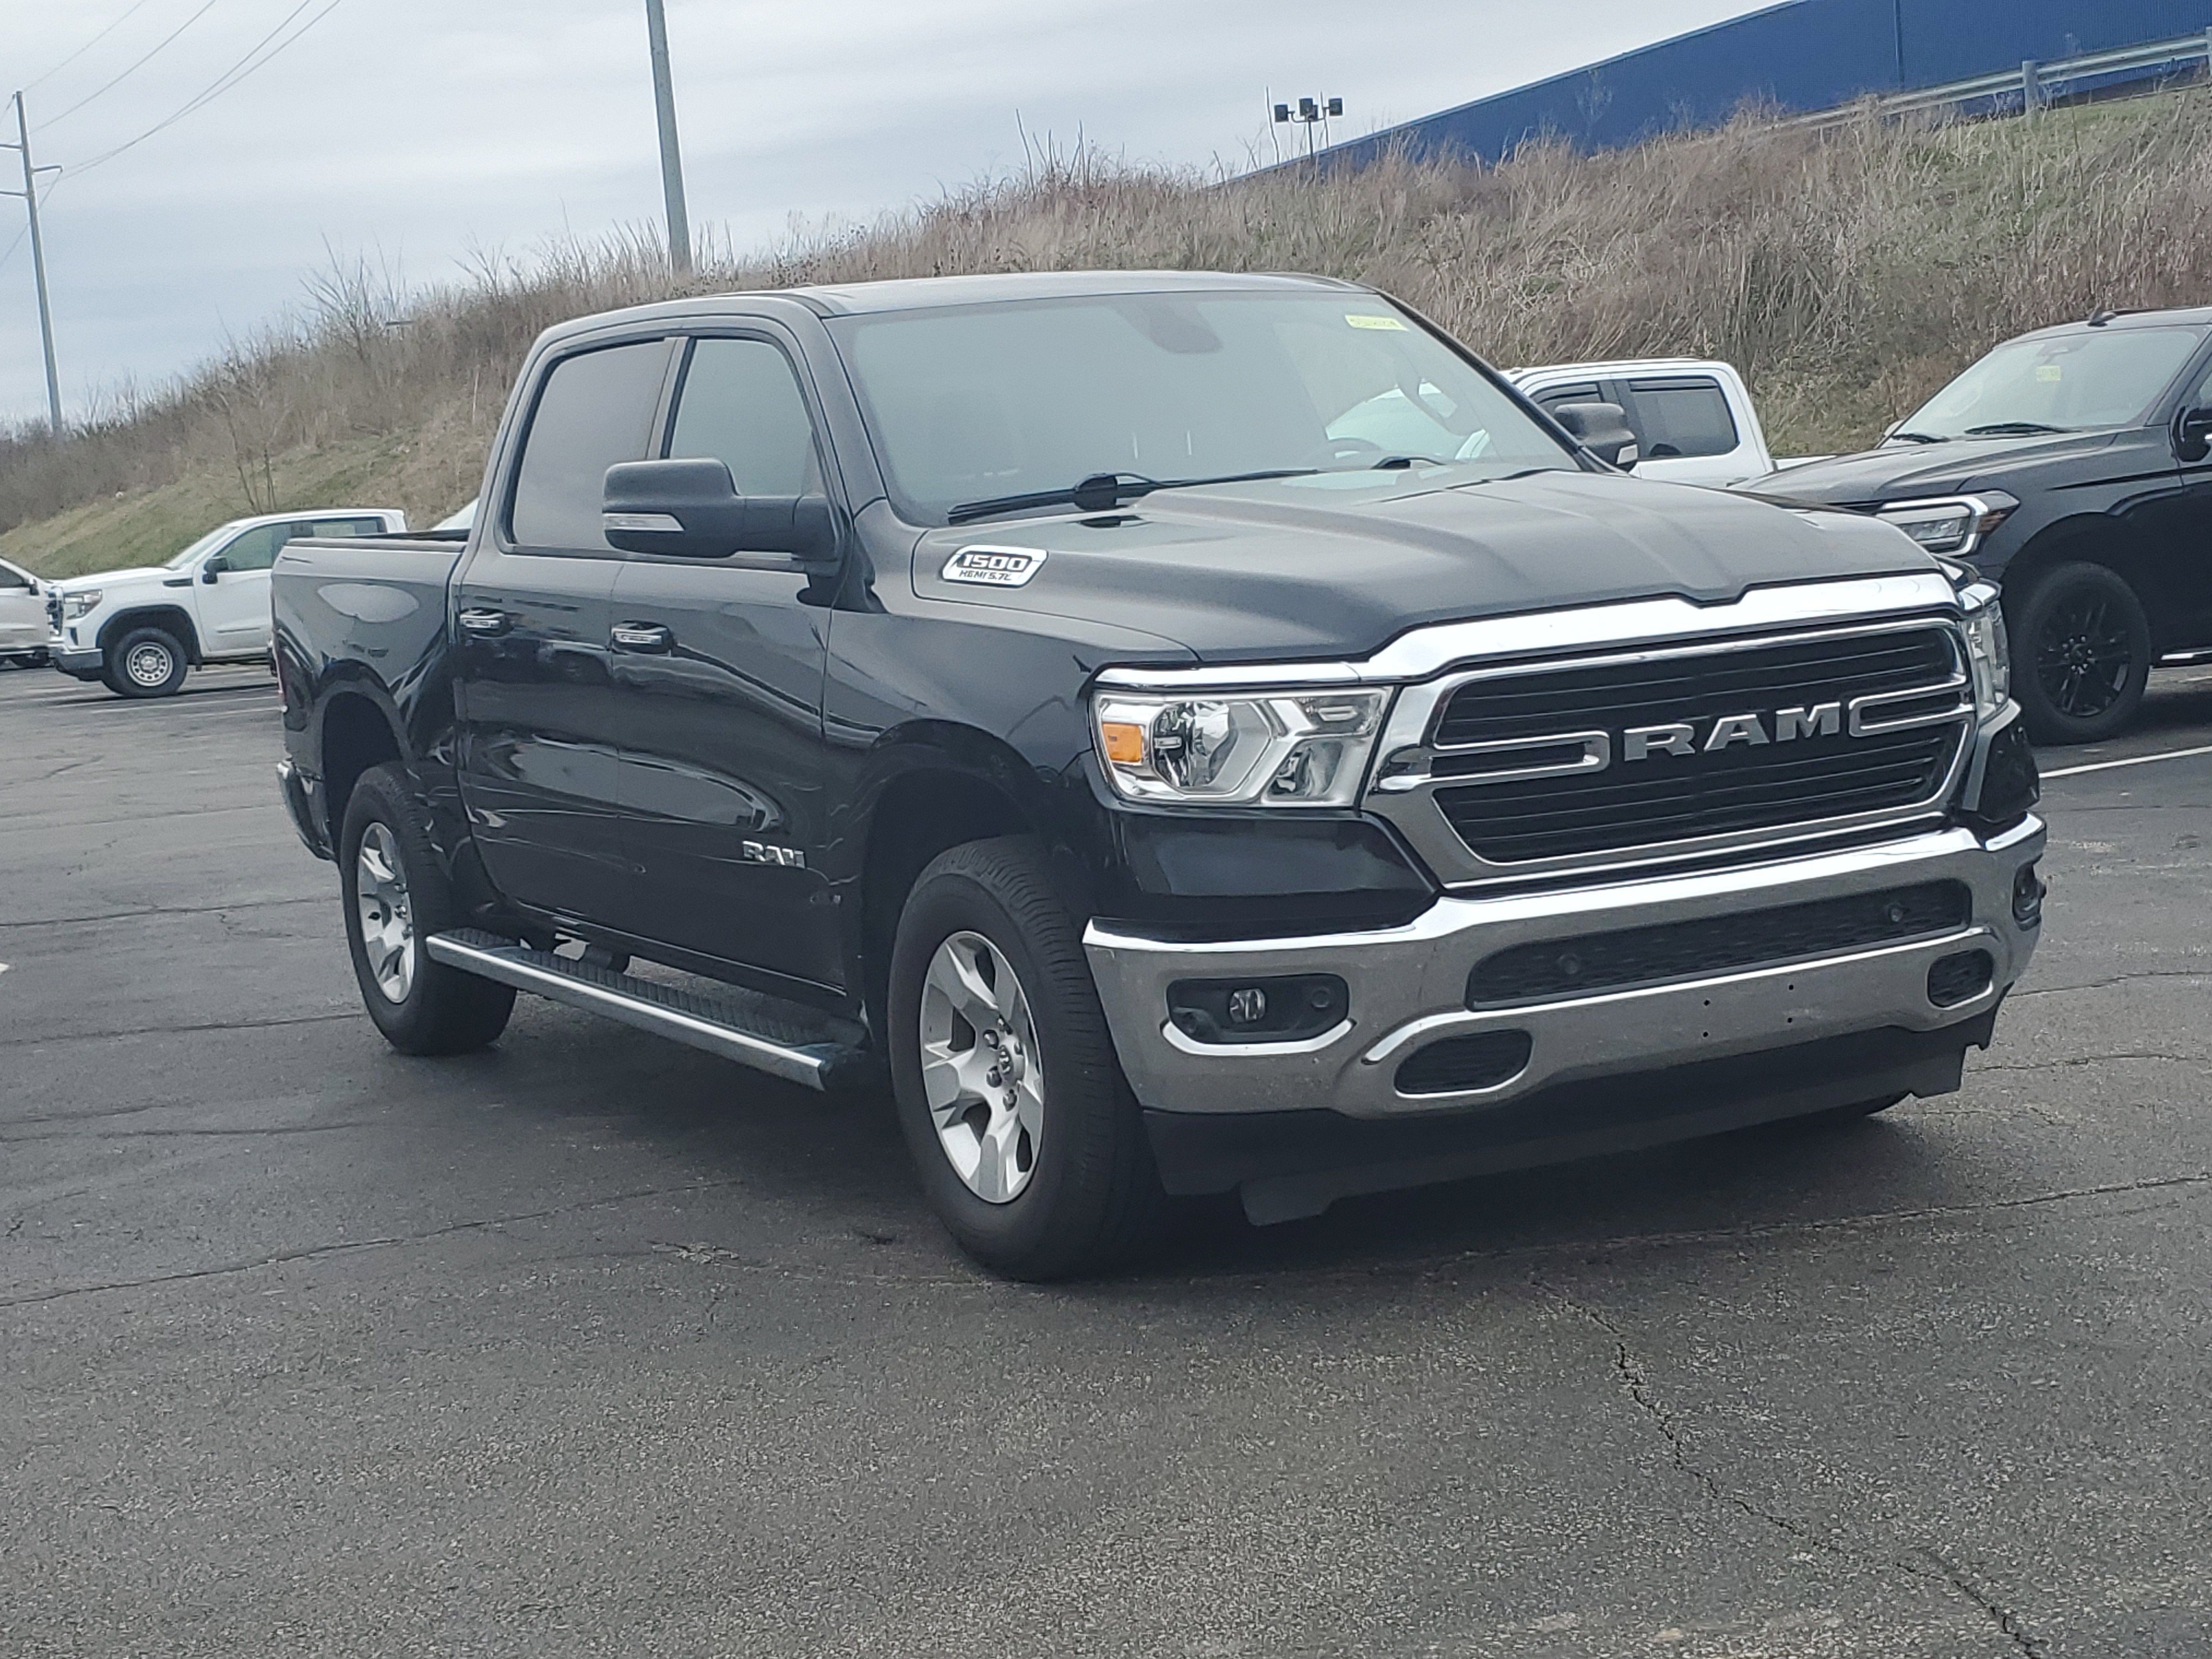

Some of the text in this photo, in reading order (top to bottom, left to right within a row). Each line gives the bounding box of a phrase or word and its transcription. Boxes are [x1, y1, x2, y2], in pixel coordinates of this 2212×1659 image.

[962, 553, 1030, 571] 1500
[959, 569, 1013, 581] HEMI 5.7L
[1623, 701, 1841, 762] RAM
[742, 840, 805, 869] RAM
